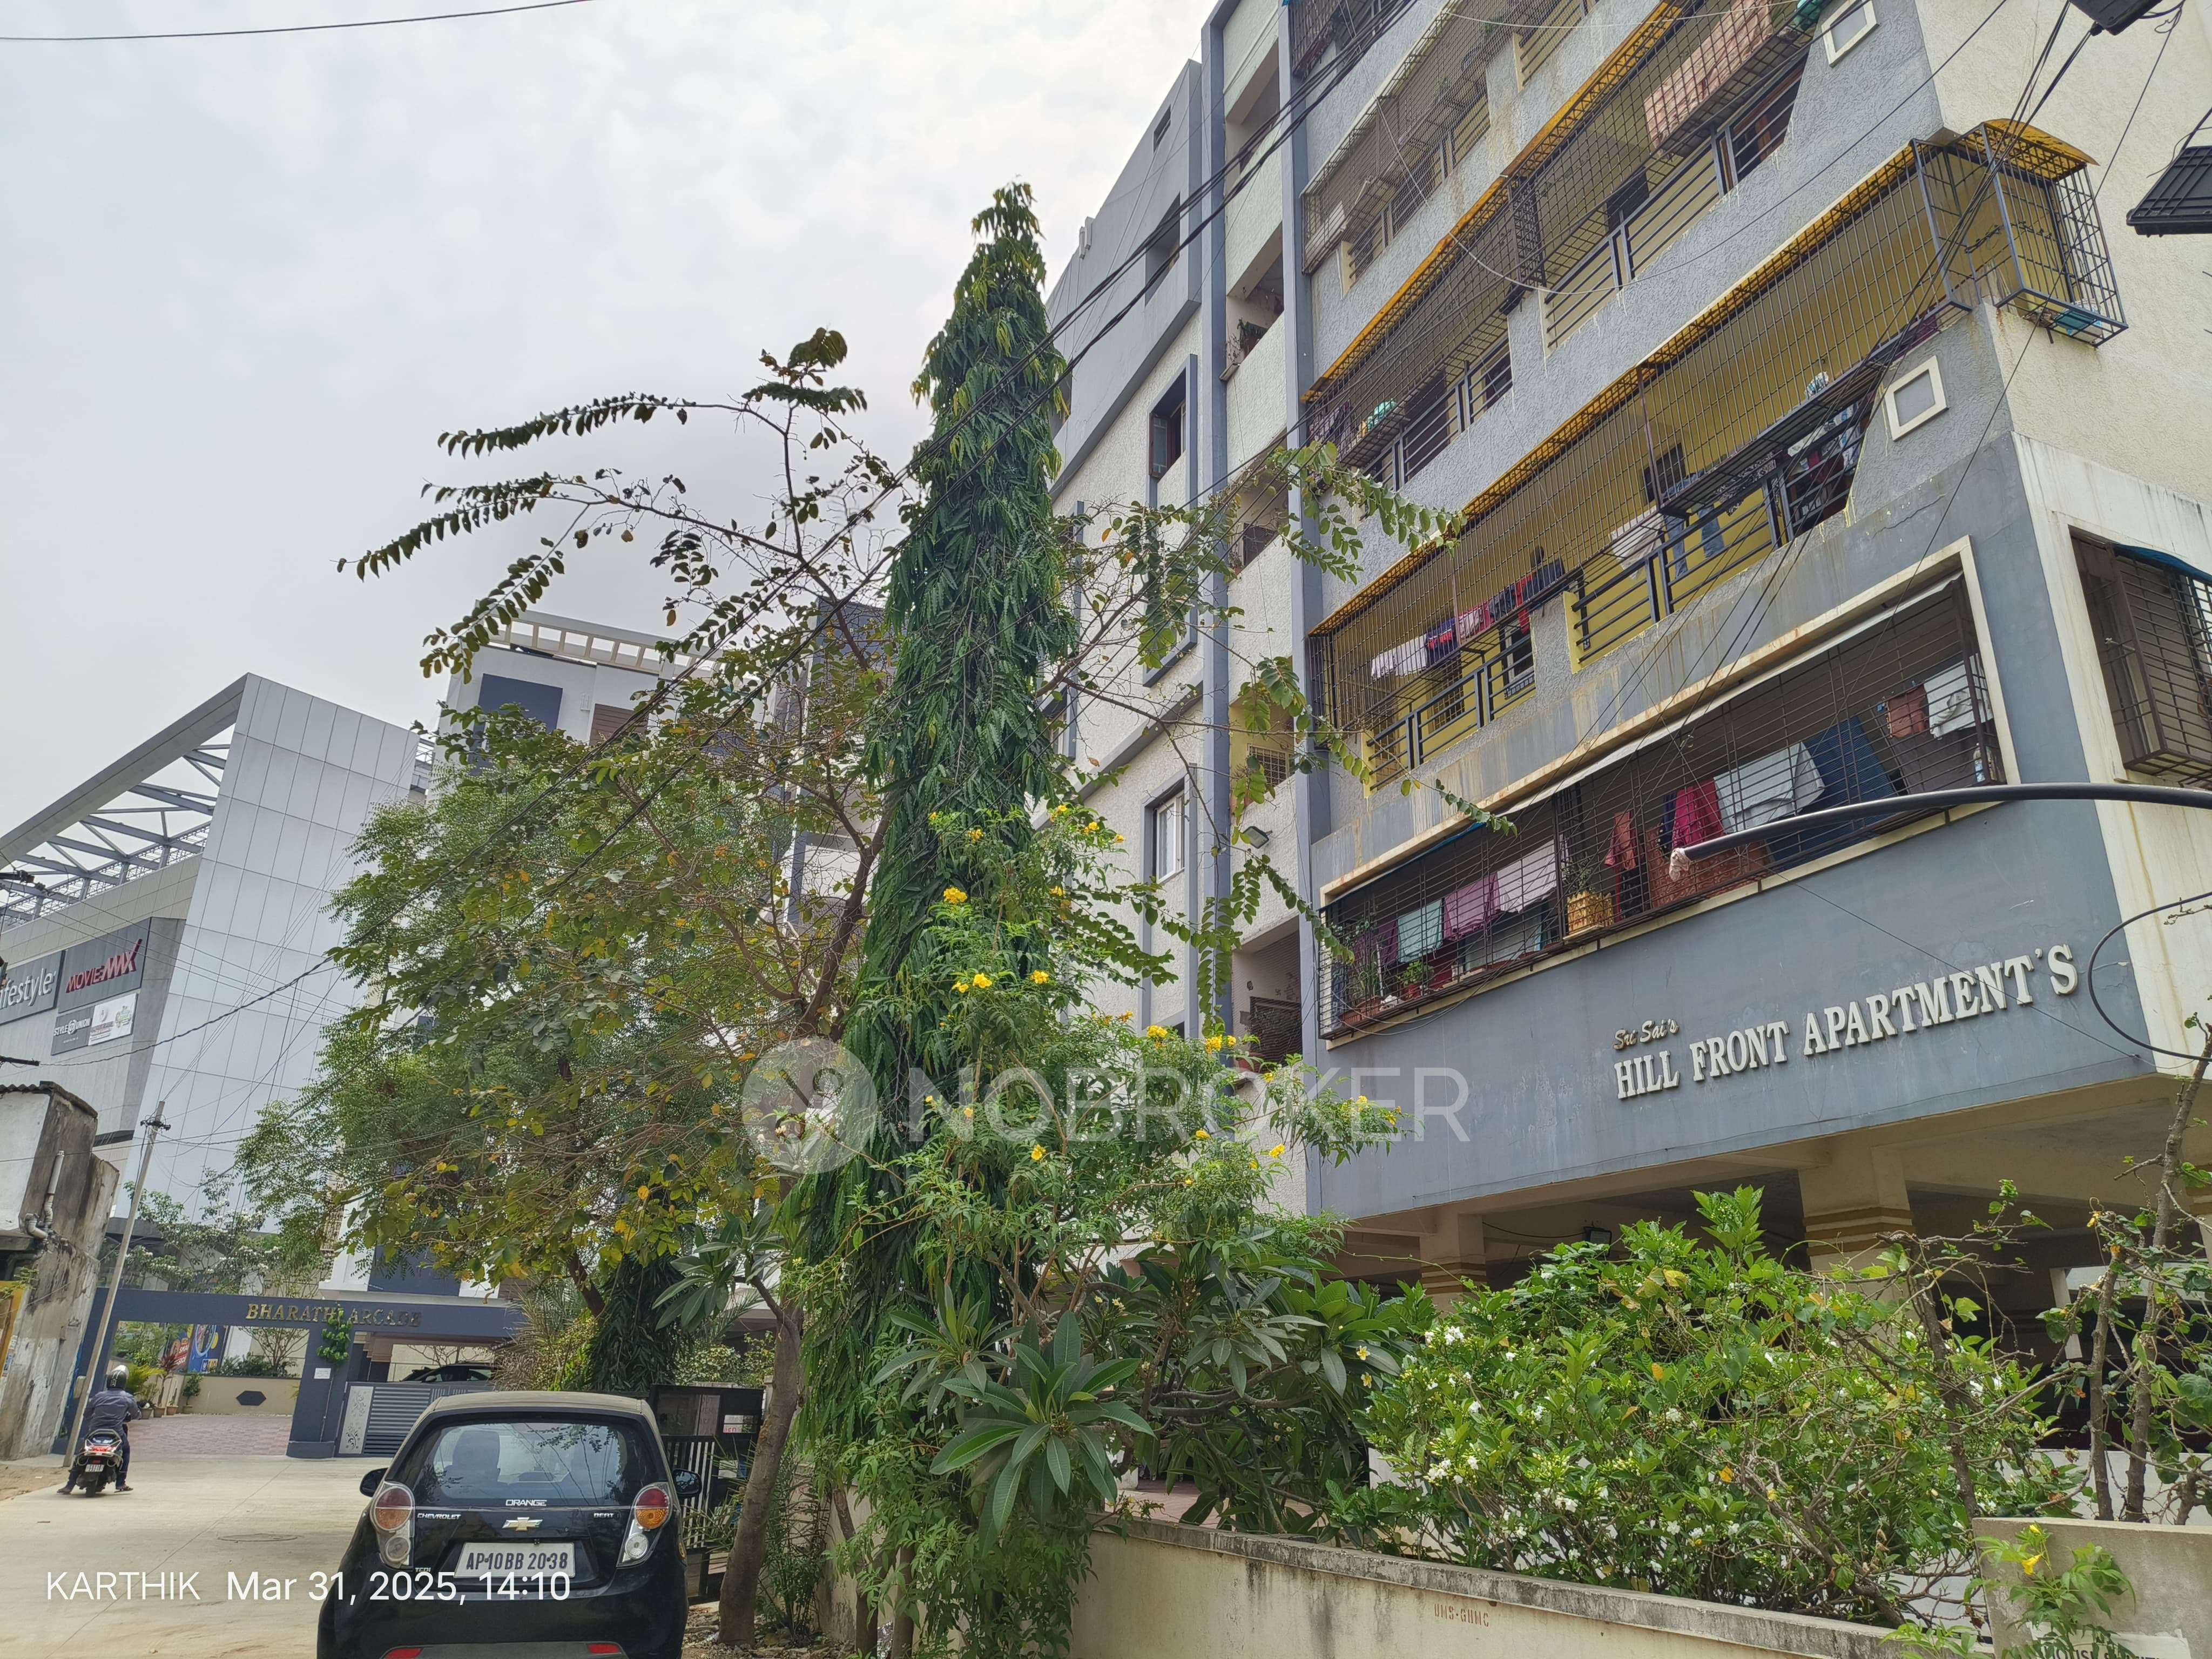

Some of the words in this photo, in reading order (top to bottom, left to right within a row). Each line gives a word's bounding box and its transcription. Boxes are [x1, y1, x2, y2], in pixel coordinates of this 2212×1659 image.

[0, 968, 53, 1009] ifestyle
[54, 1025, 68, 1036] STYLE
[76, 1018, 91, 1030] UNION
[1613, 1029, 1637, 1050] Sri
[1640, 1019, 1679, 1042] Sai's
[1614, 1049, 1681, 1099] HILL
[1689, 1020, 1790, 1081] FRONT
[1803, 943, 2079, 1056] APARTMENT'S
[246, 1303, 344, 1323] BHARATH
